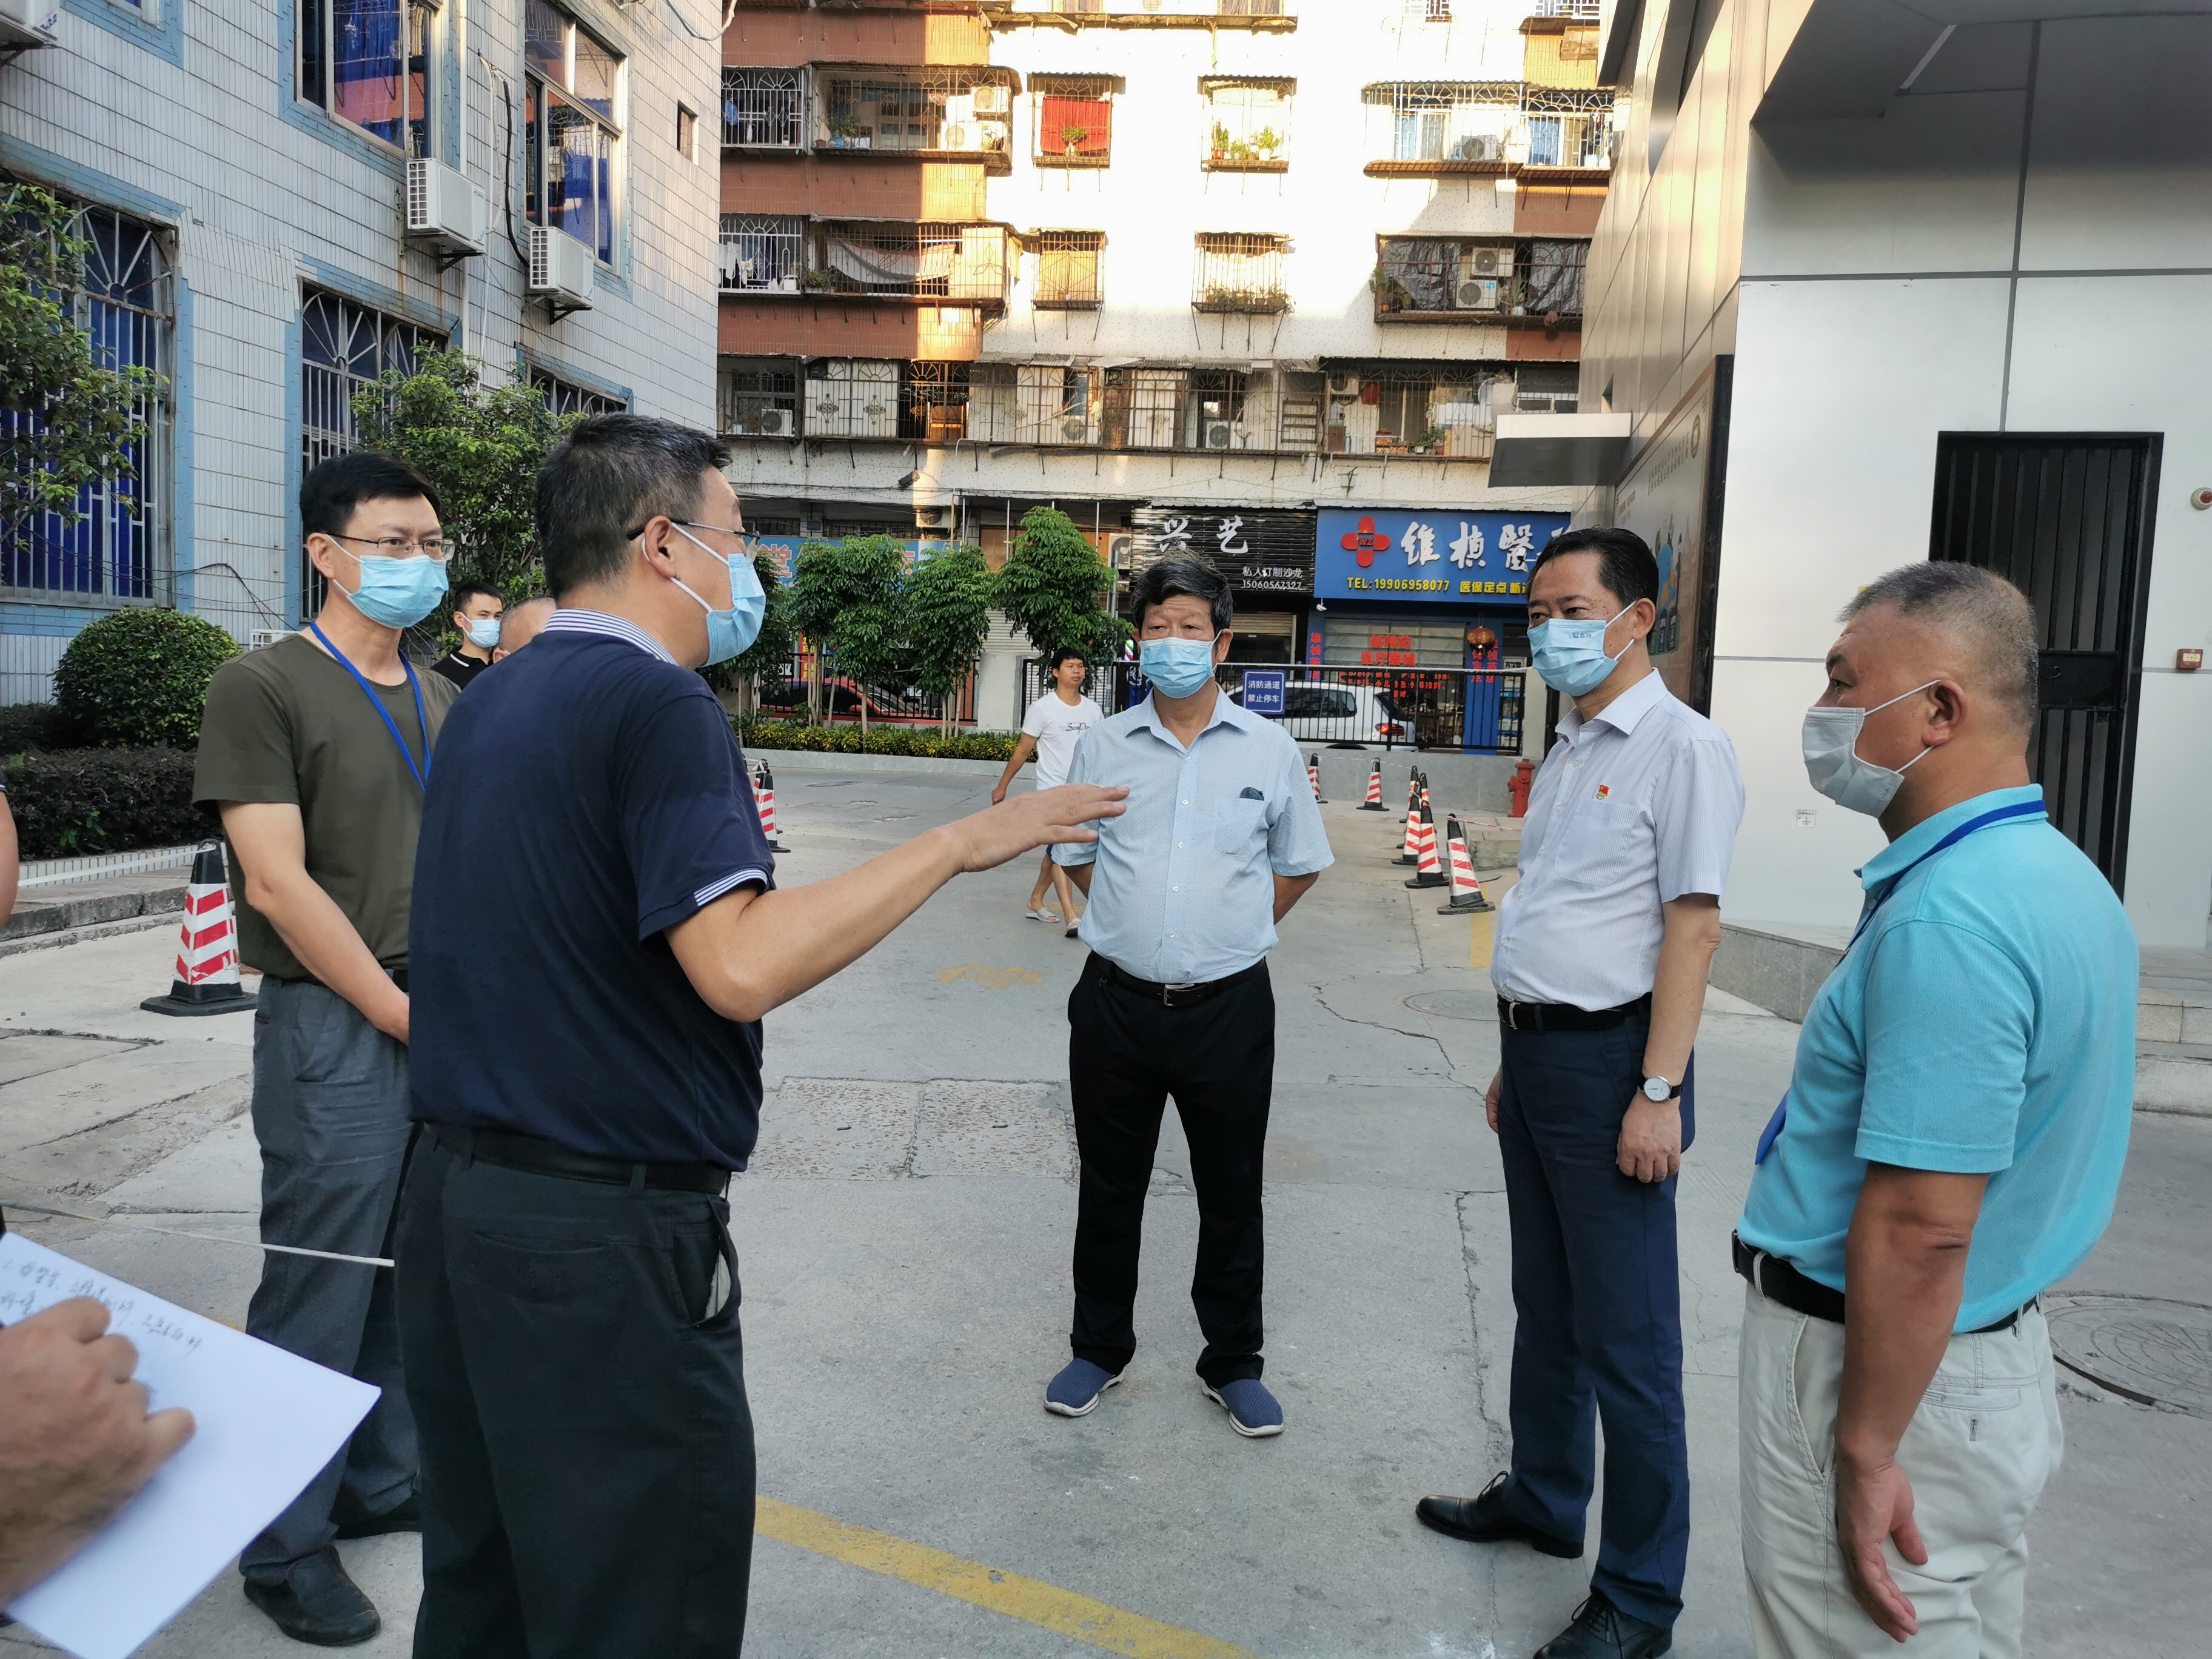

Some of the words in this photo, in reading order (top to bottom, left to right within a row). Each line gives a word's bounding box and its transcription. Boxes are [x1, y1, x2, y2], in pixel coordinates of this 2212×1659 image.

[1358, 538, 1374, 546] WZ
[1242, 567, 1303, 578] 私人订制沙龙
[1242, 580, 1302, 590] 15060567327
[1370, 634, 1412, 649] 新特药
[1361, 651, 1416, 666] 医疗器械
[1248, 680, 1280, 689] 消防通道
[1247, 694, 1279, 703] 禁止停车
